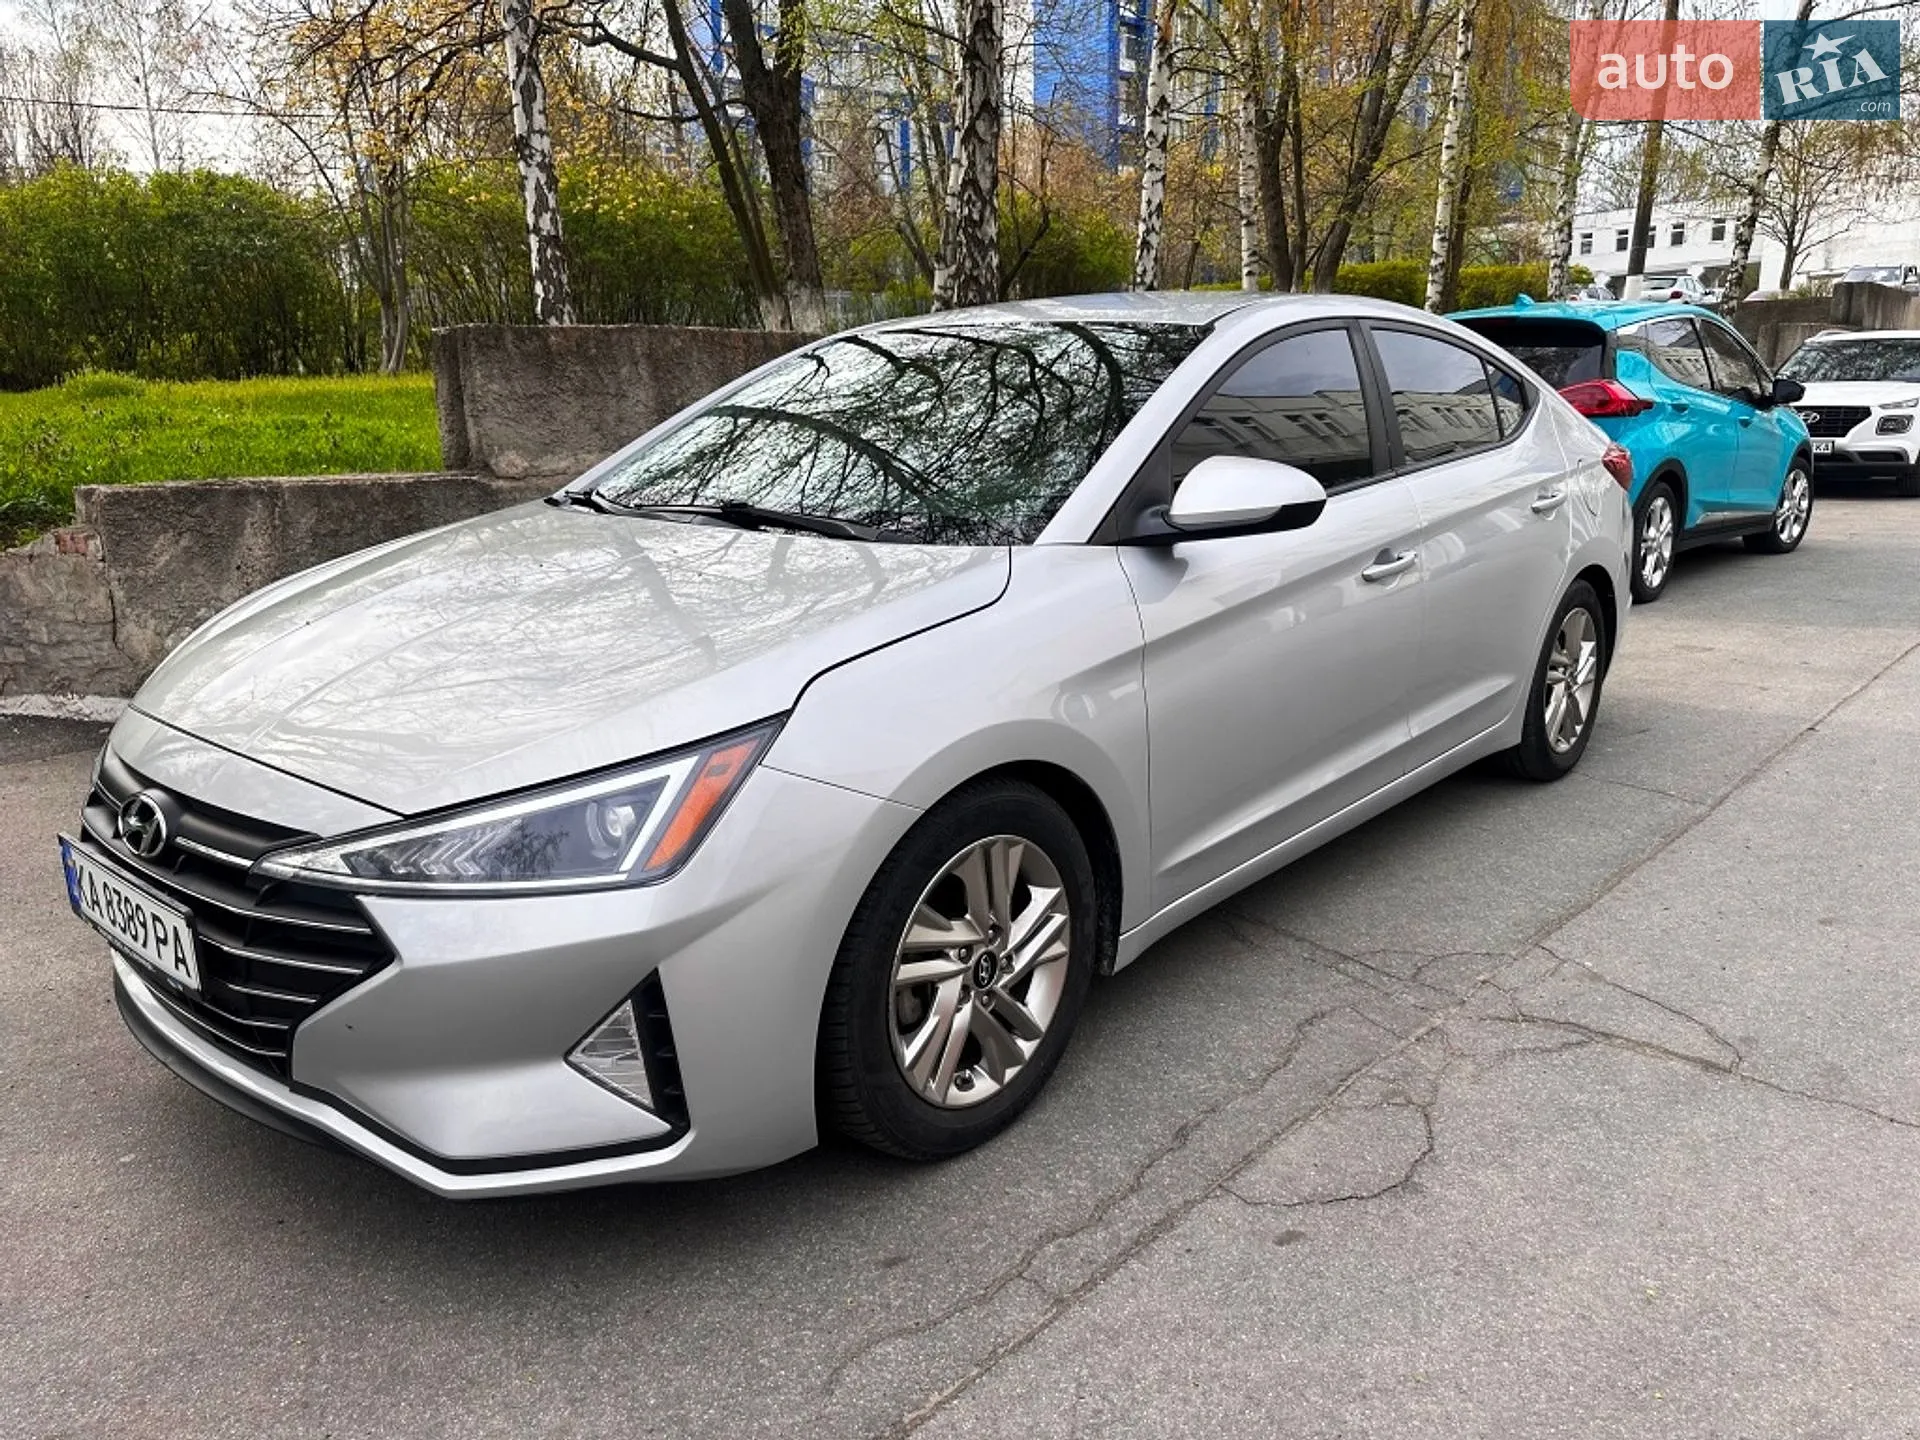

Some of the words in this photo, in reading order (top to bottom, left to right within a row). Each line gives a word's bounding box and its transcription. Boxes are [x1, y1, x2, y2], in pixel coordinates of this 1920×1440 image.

[77, 864, 104, 919] KA
[103, 881, 149, 949] 8389
[151, 911, 192, 978] PA
